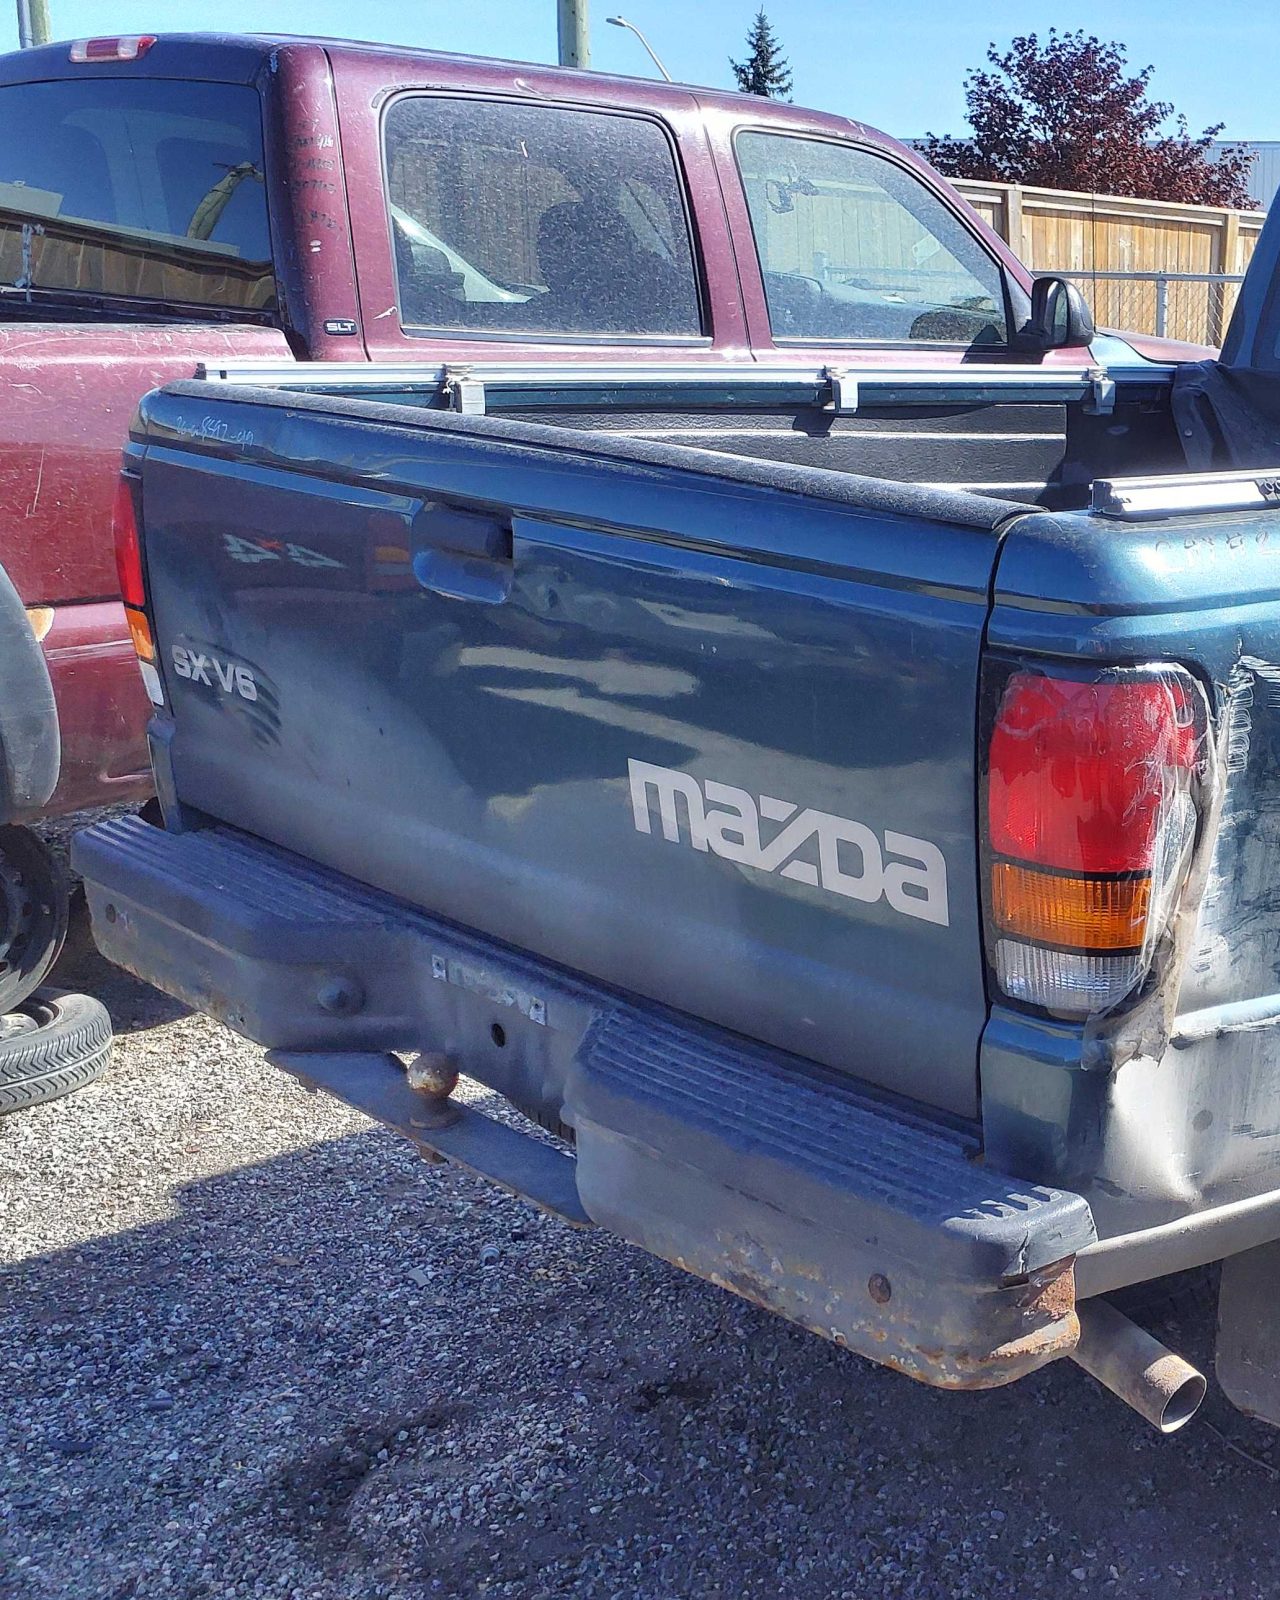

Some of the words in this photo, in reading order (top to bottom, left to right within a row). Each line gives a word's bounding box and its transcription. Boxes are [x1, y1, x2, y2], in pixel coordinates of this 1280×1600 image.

[326, 322, 355, 332] SLT
[171, 644, 213, 687] SX
[211, 657, 258, 702] V6
[627, 757, 950, 927] mazda
